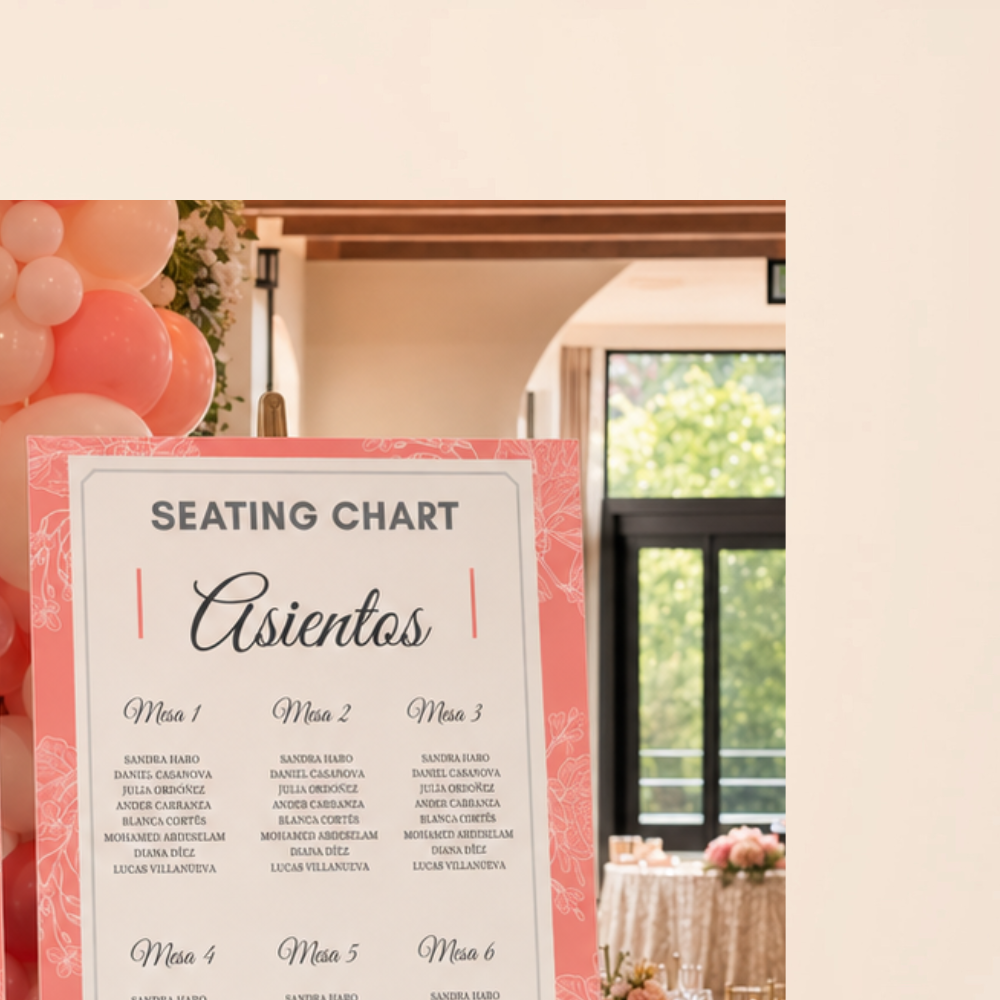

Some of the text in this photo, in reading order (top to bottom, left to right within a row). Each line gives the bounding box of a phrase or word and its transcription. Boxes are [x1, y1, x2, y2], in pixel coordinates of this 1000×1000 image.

[152, 501, 459, 531] SEATING CHART
[190, 571, 432, 653] Asientos
[123, 697, 201, 725] Mesa 1
[272, 697, 351, 725] Mesa 2
[407, 697, 483, 725] Mesa 3
[122, 817, 164, 826] BLANCA
[278, 816, 319, 825] BLANCA
[420, 815, 458, 824] BLANCA
[113, 864, 216, 874] LUCAS VILLANUEVA
[271, 862, 370, 872] LUCAS VILLANUEVA
[413, 861, 506, 871] LUCAS VILLANUEVA
[130, 938, 215, 968] Mesa 4
[278, 936, 359, 966] Mesa 5
[418, 935, 495, 964] Mesa 6
